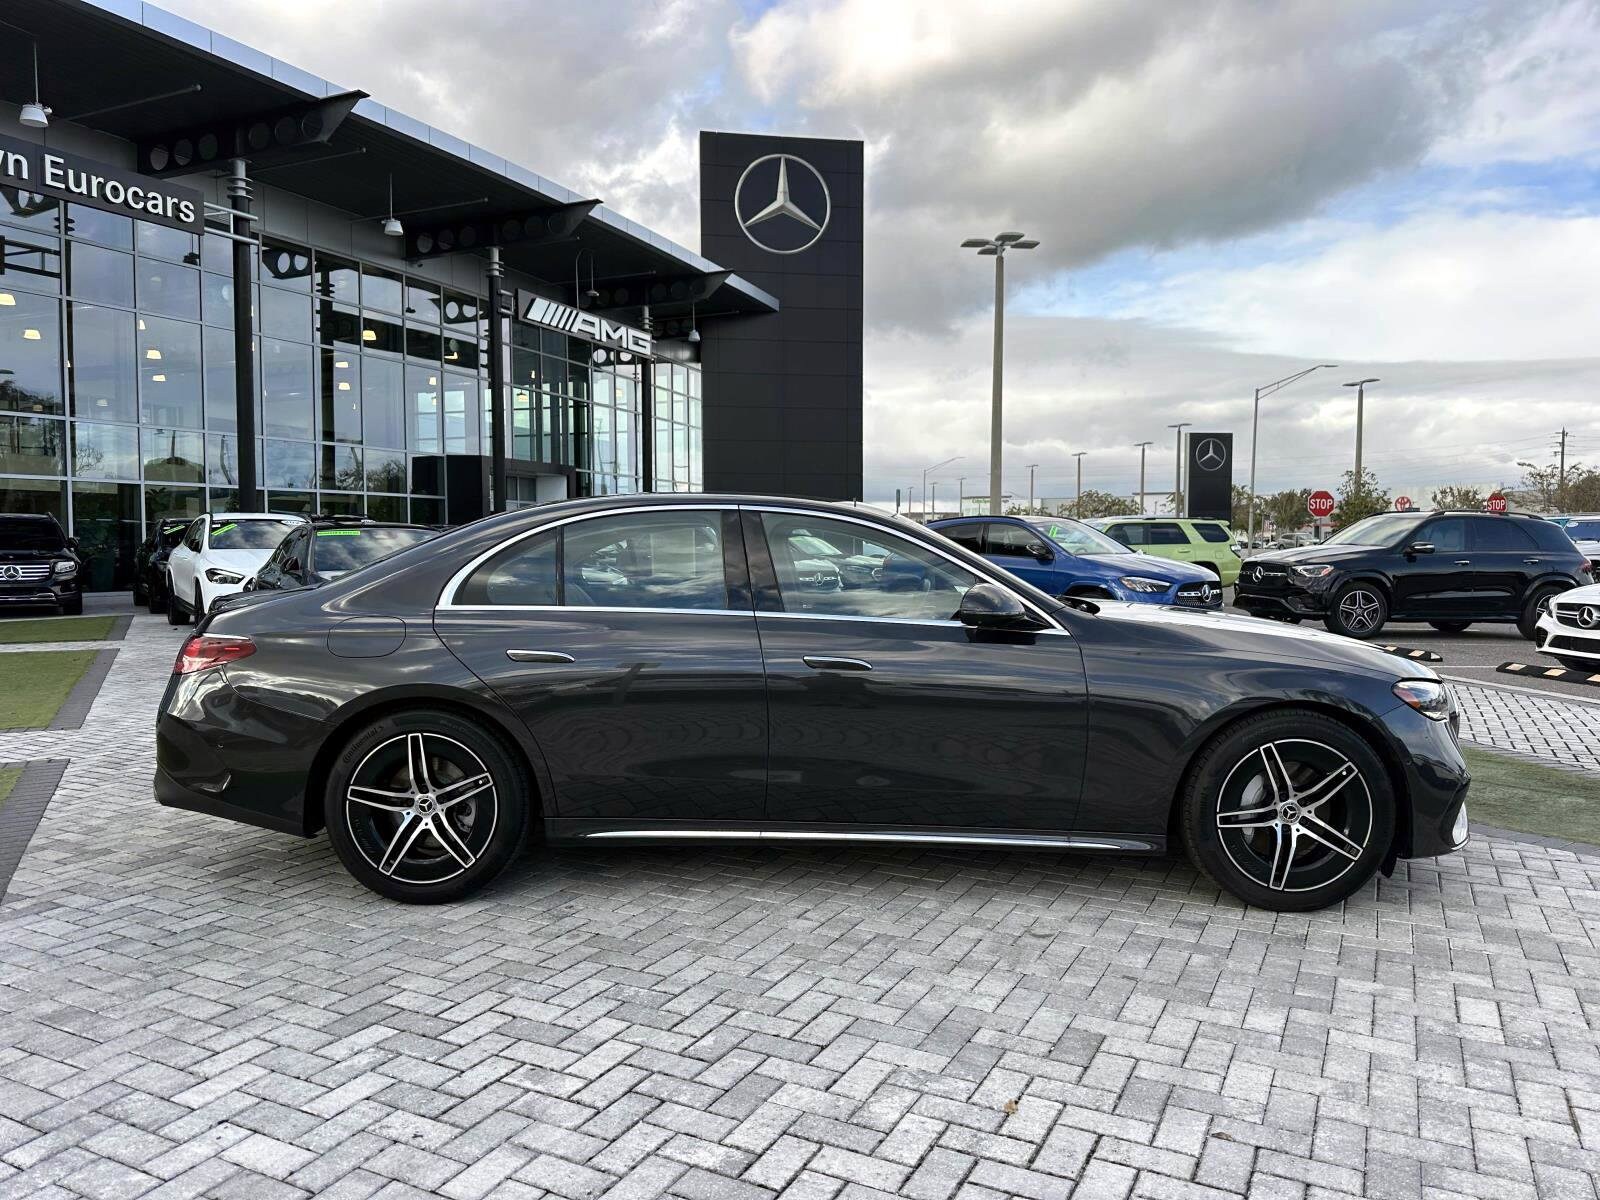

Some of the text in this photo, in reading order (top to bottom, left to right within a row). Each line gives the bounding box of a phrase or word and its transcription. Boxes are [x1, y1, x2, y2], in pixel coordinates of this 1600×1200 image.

[44, 153, 196, 223] Eurocars
[570, 311, 651, 356] AMG
[1309, 499, 1334, 511] STOP
[1487, 500, 1506, 511] STOP
